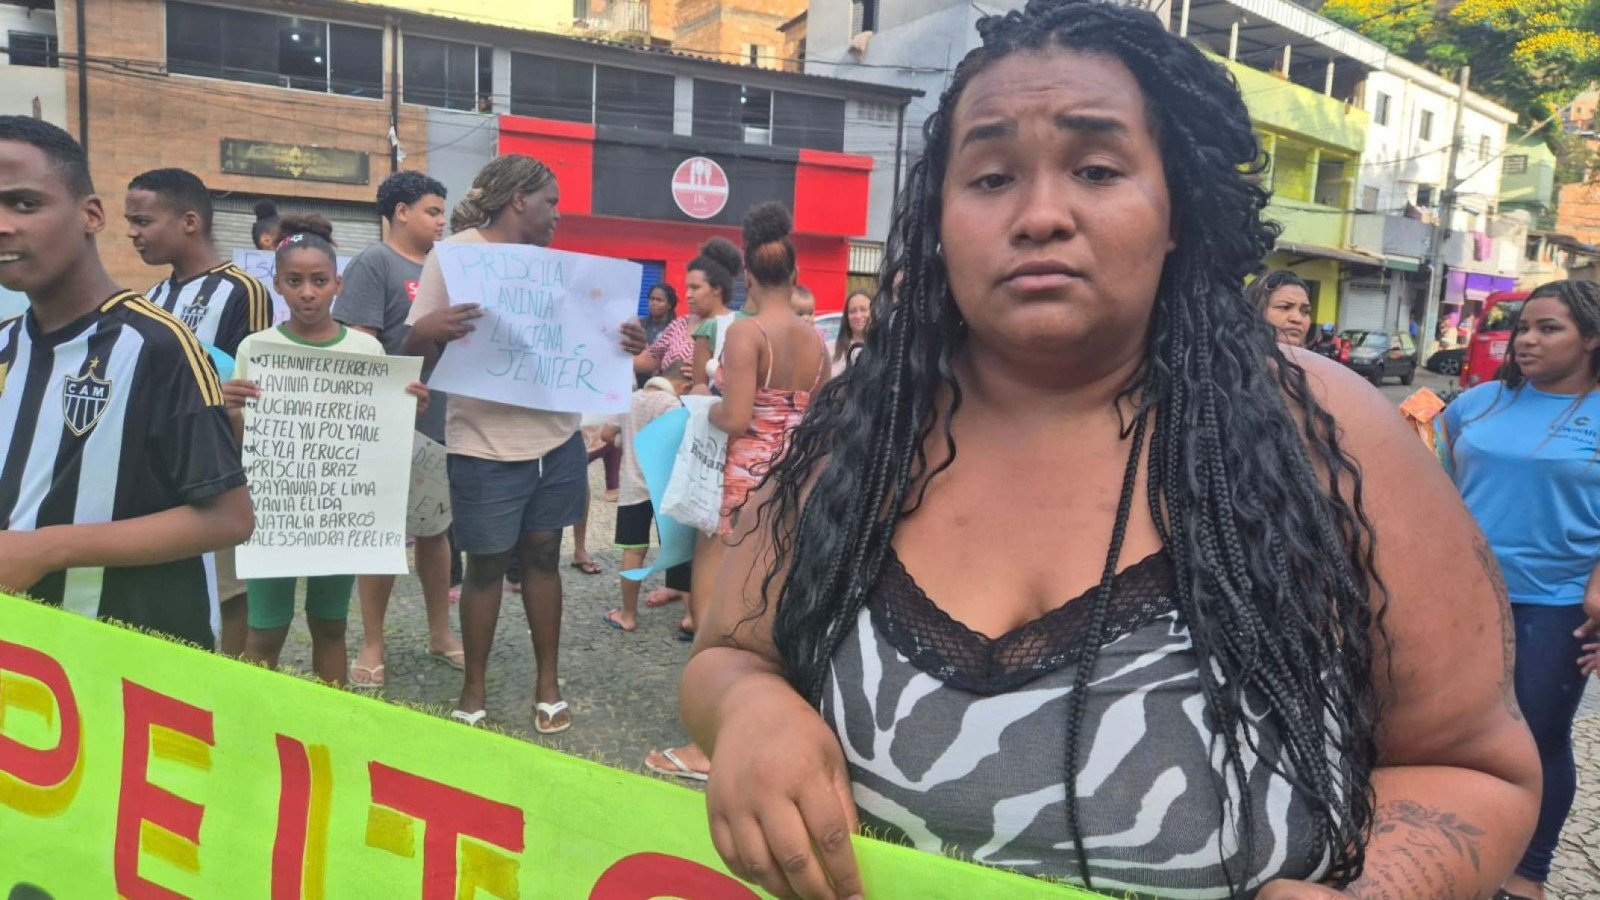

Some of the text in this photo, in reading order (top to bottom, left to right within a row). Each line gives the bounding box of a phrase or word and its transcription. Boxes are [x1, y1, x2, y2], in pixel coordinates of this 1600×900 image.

[452, 246, 564, 288] PRISCILA
[482, 284, 555, 320] LAVINIA
[259, 354, 388, 376] JHENNIFER FERREIRA
[67, 383, 105, 398] CAM
[259, 373, 373, 396] LAVINIA EDUARDA
[255, 395, 376, 422] LUCIANA FERREIRA
[318, 421, 381, 442] POLYANE
[252, 440, 295, 460] KEYLA
[252, 459, 359, 479] PRISCILA BRAZ
[251, 478, 376, 497] DAYANNA DE LIMA
[253, 497, 295, 513] VANIA
[254, 511, 376, 531] NATALIA BARROS
[252, 528, 402, 548] ALESSANDRA PEREIRA
